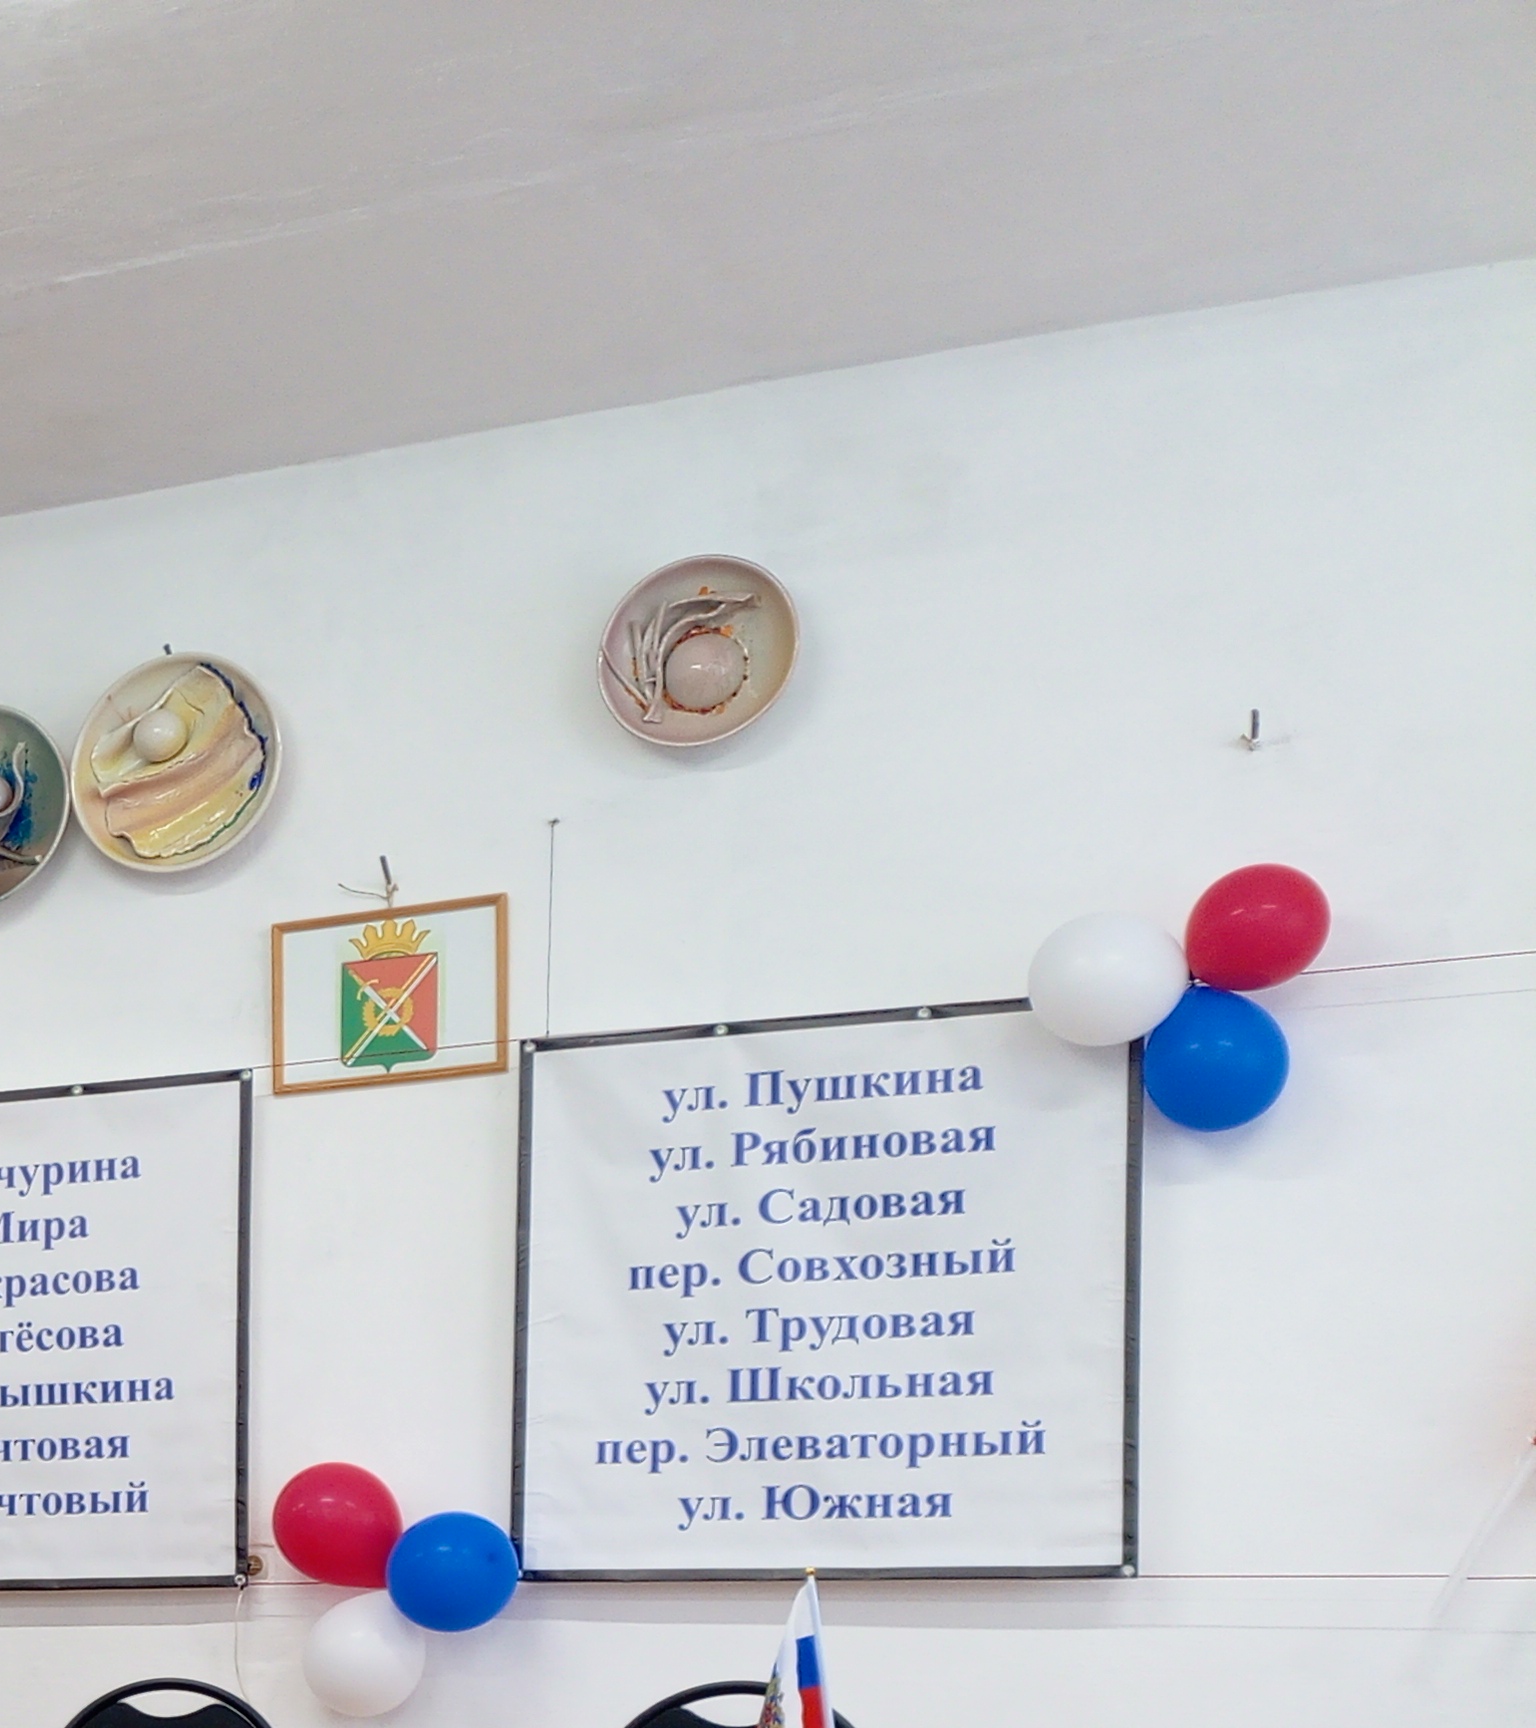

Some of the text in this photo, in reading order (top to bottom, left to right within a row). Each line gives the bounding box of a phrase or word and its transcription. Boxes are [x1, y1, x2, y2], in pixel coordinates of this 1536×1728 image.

[662, 1065, 984, 1124] ул. Пушкина
[649, 1125, 996, 1183] ул. Рябиновая
[675, 1188, 966, 1240] ул. Садовая
[629, 1237, 1016, 1298] пер. Совхозный
[663, 1307, 975, 1357] ул. Трудовая
[644, 1366, 994, 1416] ул. Школьная
[596, 1419, 1046, 1474] пер. Элеваторный
[678, 1484, 952, 1531] ул. Южная
